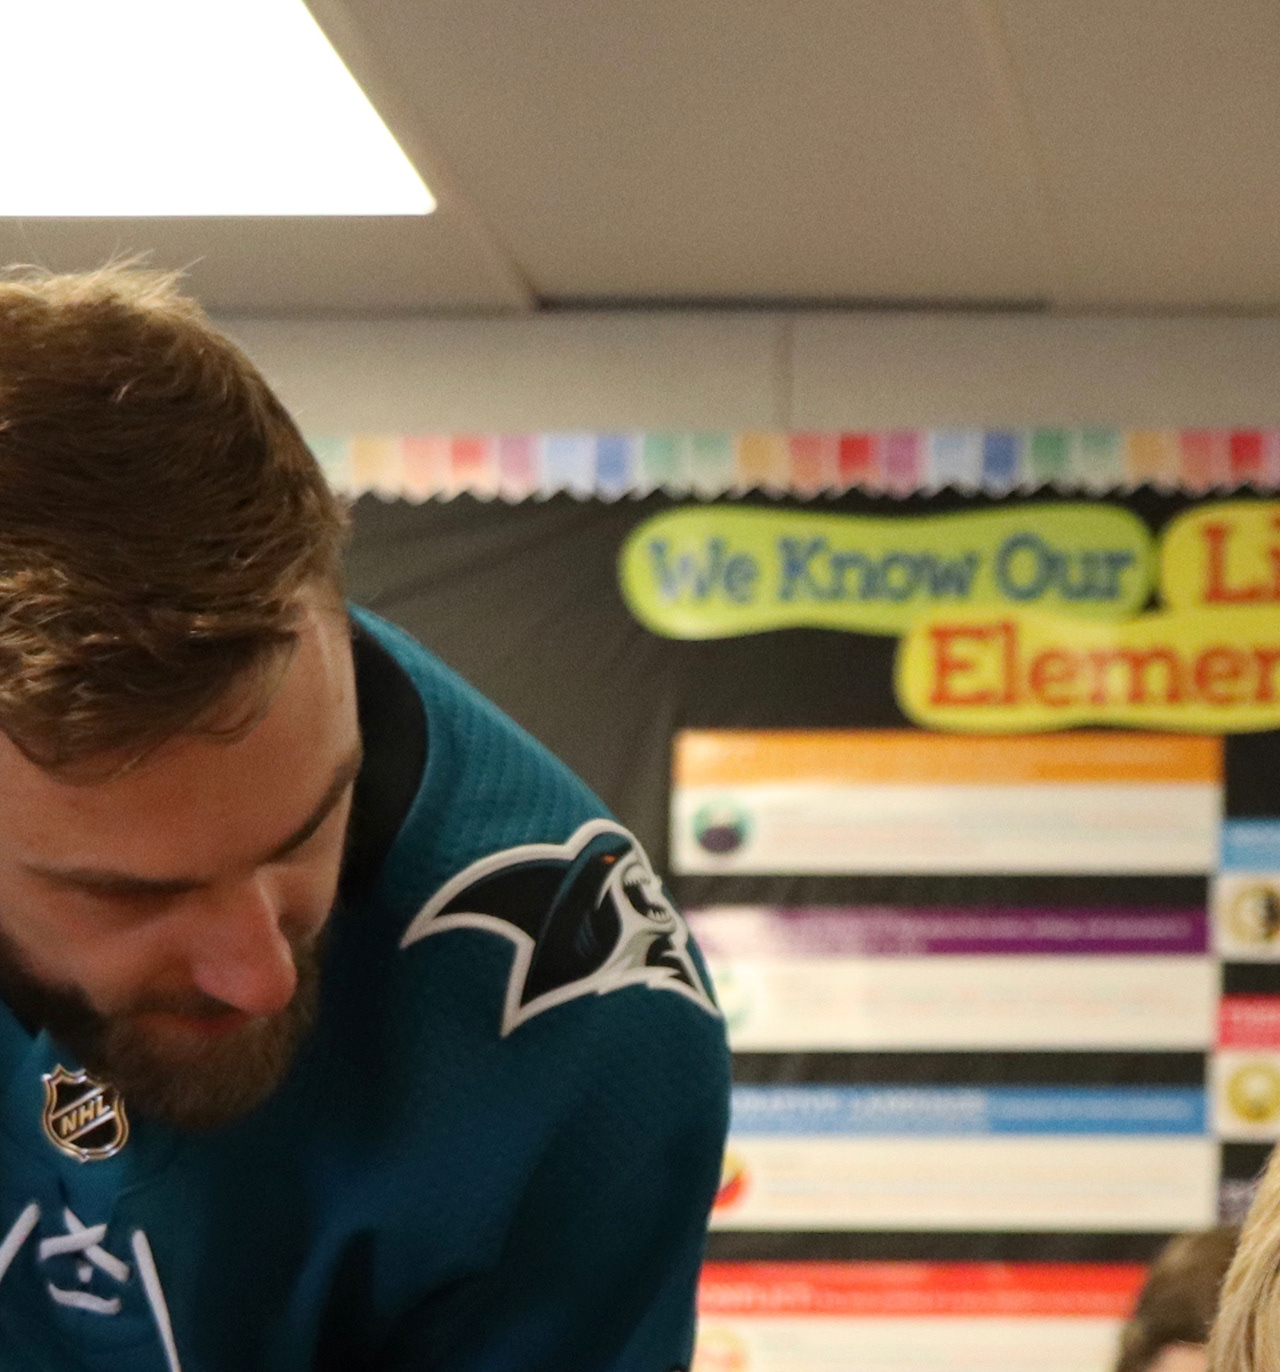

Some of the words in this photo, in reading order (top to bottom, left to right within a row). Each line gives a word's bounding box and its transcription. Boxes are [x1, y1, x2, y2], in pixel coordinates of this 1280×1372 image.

[650, 535, 758, 604] We
[776, 536, 976, 603] Know
[996, 531, 1132, 602] Our
[60, 1094, 111, 1136] NHL
